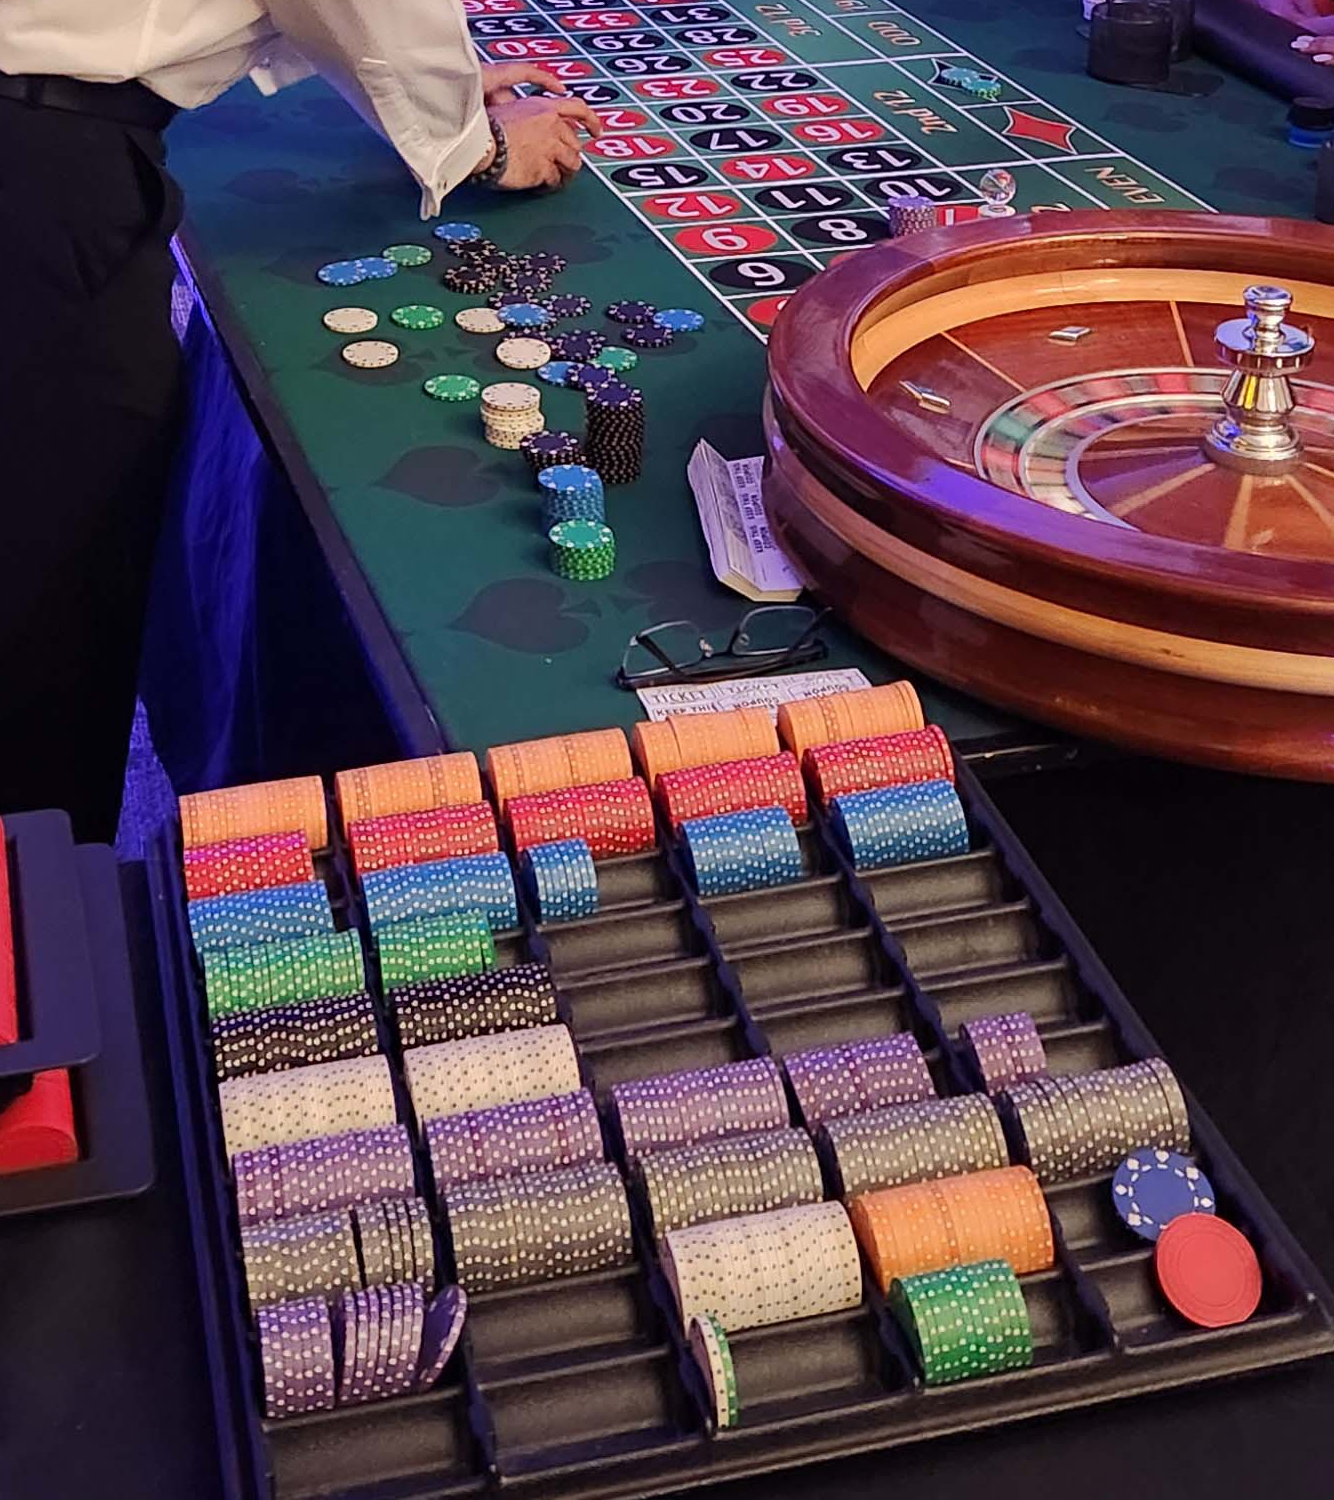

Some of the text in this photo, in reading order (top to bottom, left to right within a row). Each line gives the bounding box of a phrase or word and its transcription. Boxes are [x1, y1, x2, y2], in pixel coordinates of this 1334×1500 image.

[567, 13, 630, 28] 32
[661, 7, 718, 22] 31
[475, 18, 535, 33] 33
[868, 21, 921, 46] ODD
[592, 33, 655, 50] 29
[684, 27, 749, 44] 28
[496, 39, 559, 55] 30
[615, 56, 681, 72] 26
[713, 50, 778, 66] 25
[643, 80, 710, 97] 23
[740, 73, 809, 89] 22
[672, 104, 740, 122] 20
[773, 96, 839, 114] 19
[709, 131, 768, 150] 17
[804, 123, 873, 141] 16
[595, 138, 665, 157] 18
[735, 159, 807, 179] 14
[842, 151, 911, 170] 13
[628, 166, 698, 186] 15
[1084, 166, 1165, 203] EVEN
[879, 179, 951, 198] 10
[655, 195, 732, 216] 12
[770, 188, 841, 209] 11
[818, 219, 867, 240] 8
[702, 228, 748, 250] 9
[737, 262, 785, 286] 6
